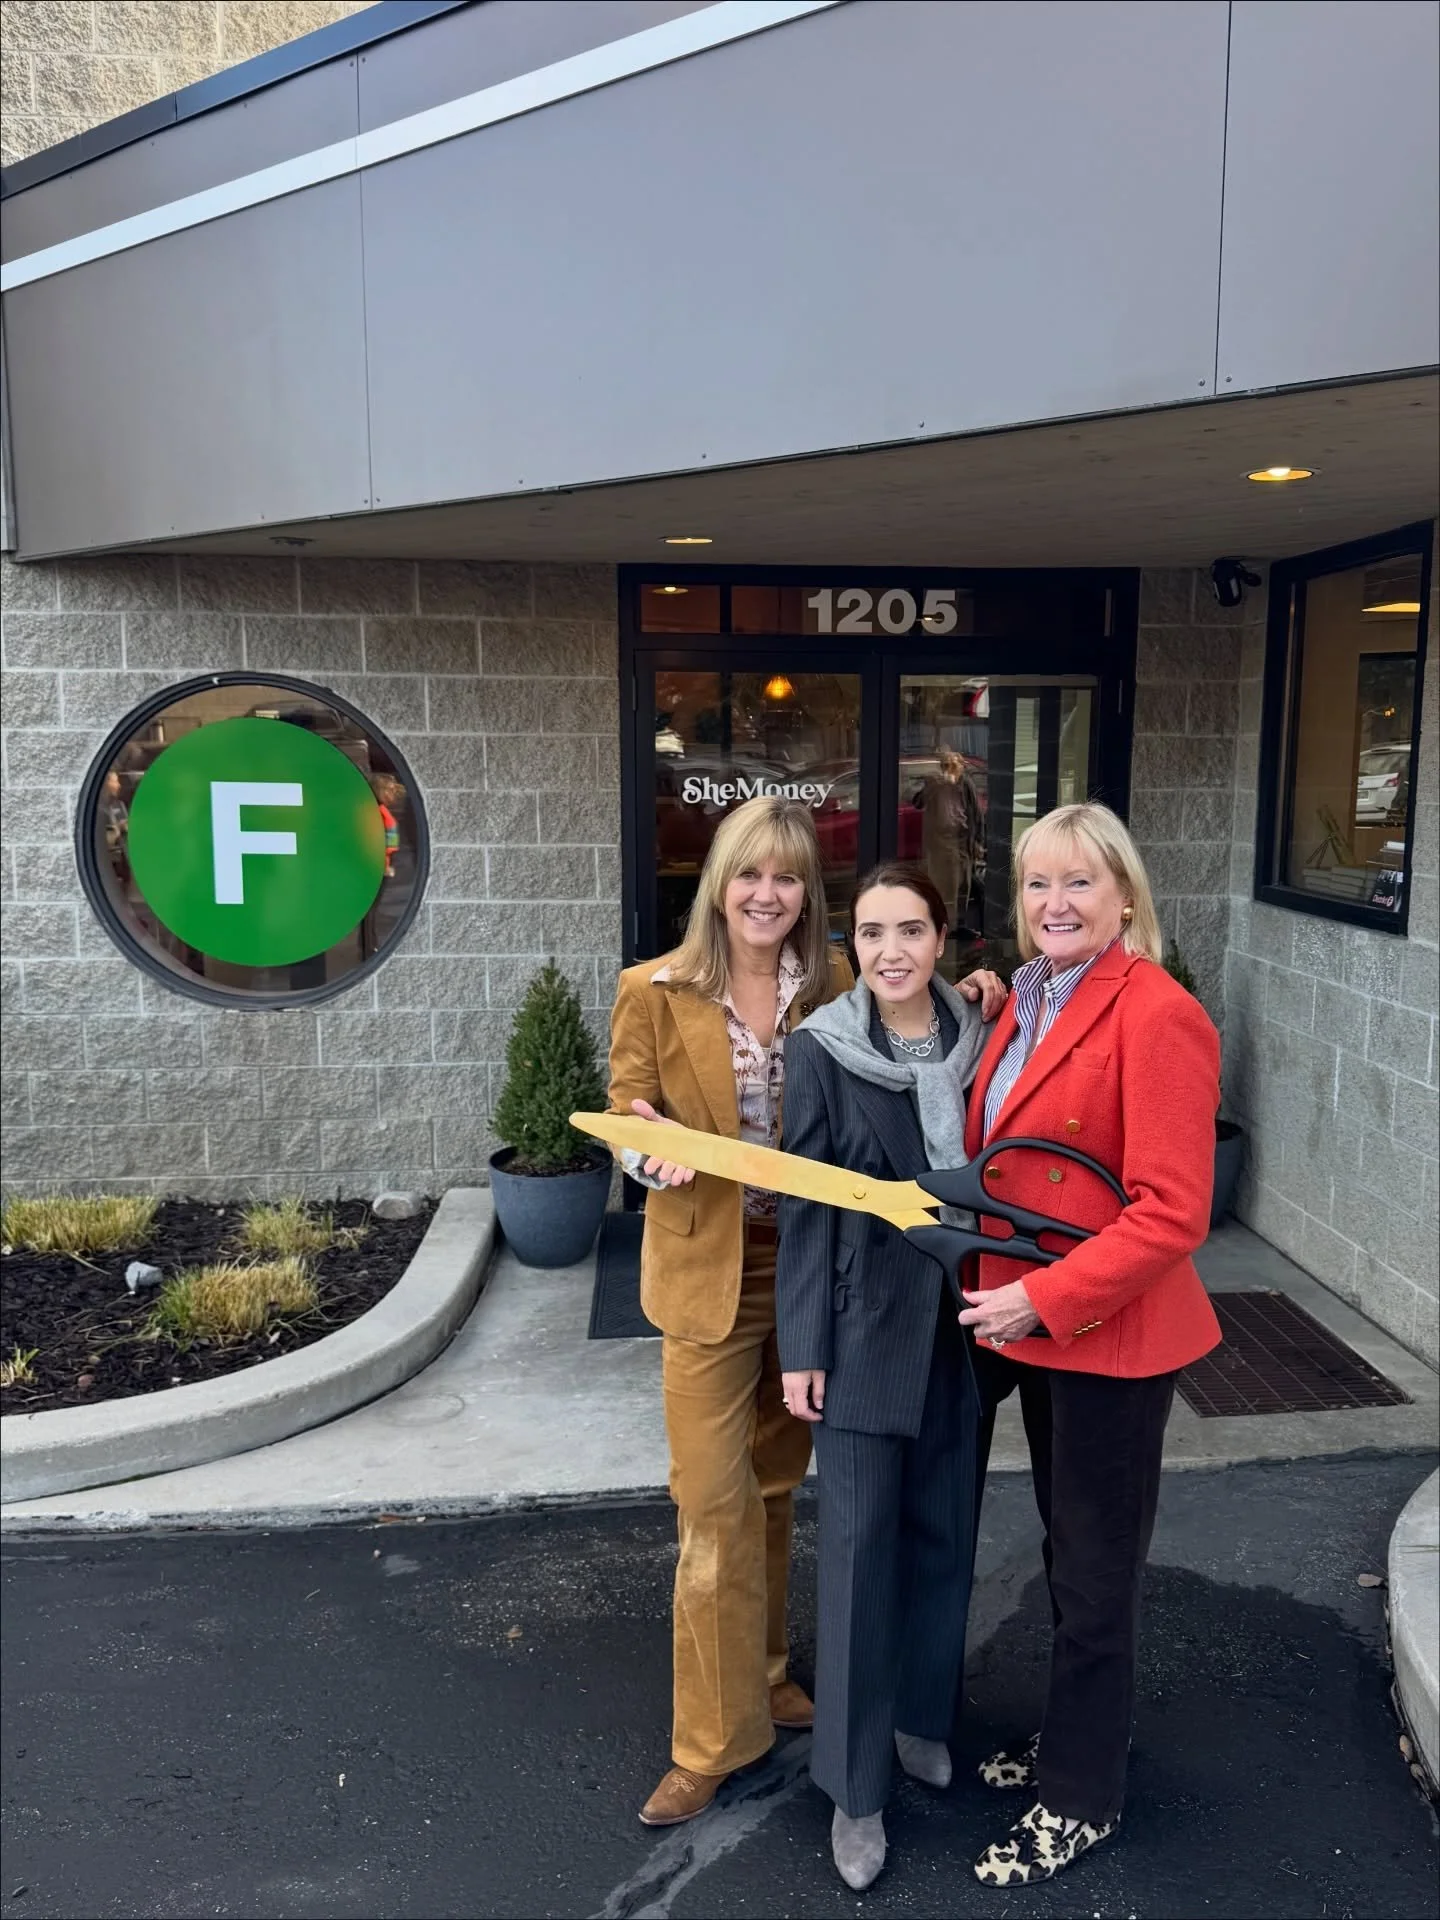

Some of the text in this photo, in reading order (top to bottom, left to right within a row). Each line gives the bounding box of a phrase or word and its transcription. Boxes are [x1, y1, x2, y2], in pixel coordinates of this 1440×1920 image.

[807, 588, 958, 634] 1205
[682, 776, 834, 808] SheMoney
[210, 781, 303, 904] F
